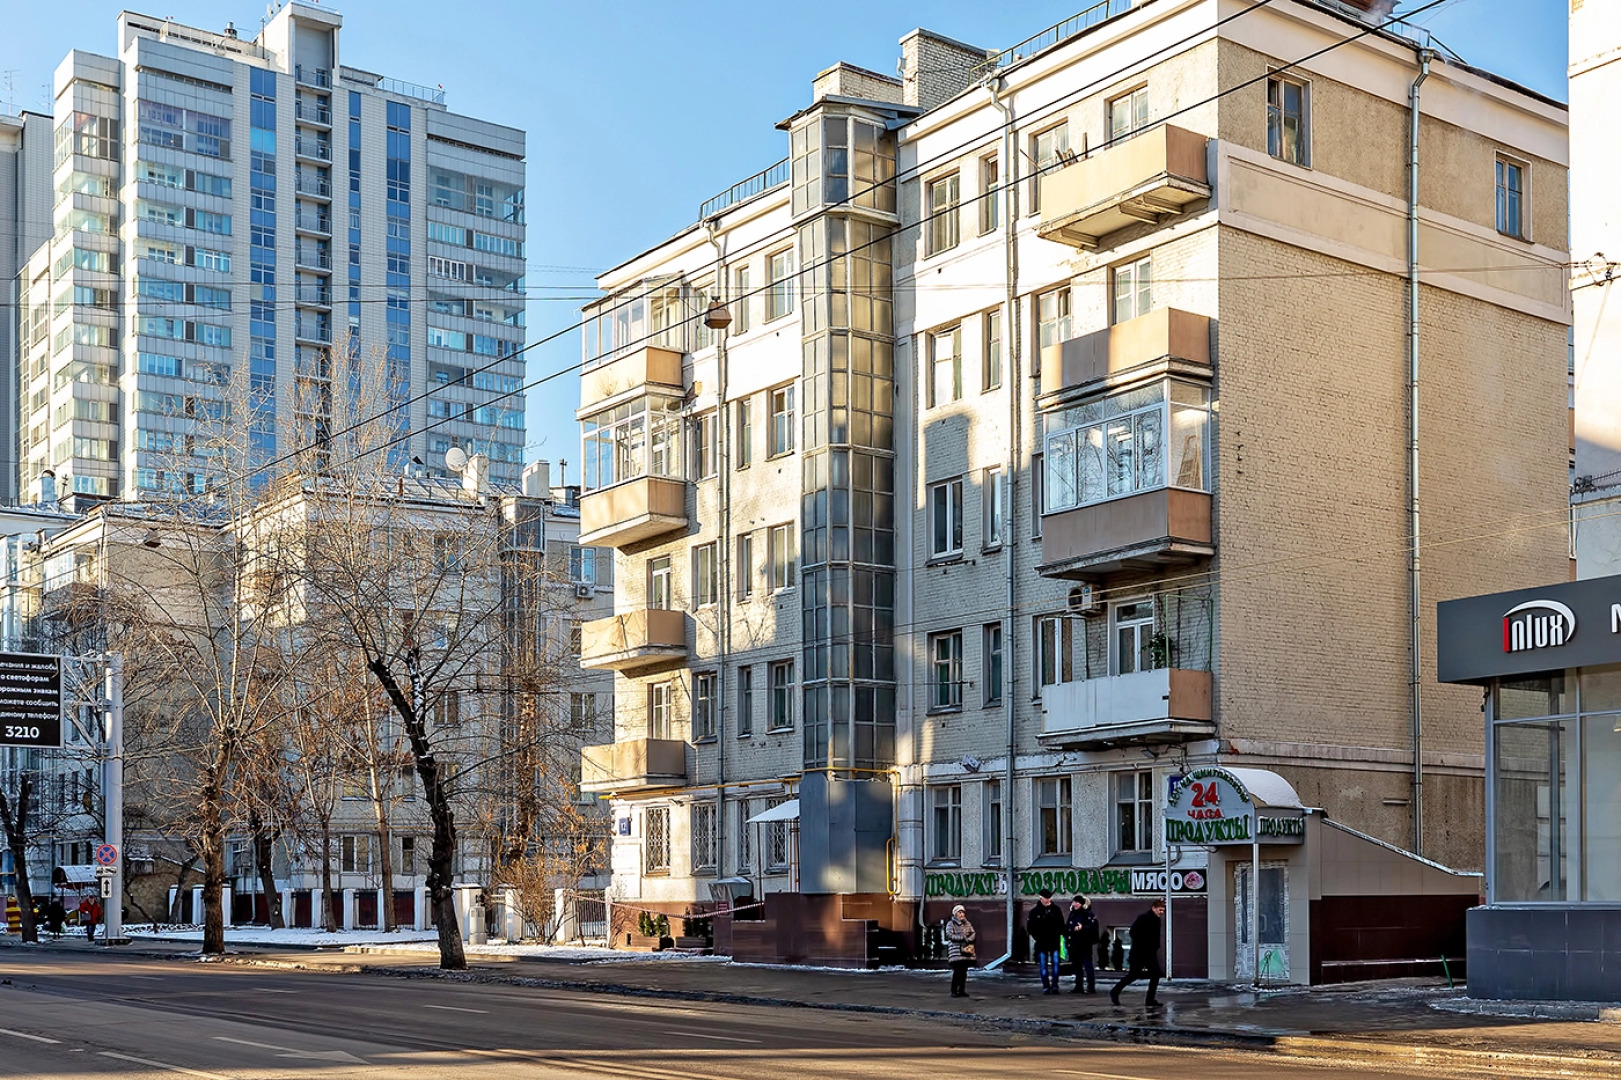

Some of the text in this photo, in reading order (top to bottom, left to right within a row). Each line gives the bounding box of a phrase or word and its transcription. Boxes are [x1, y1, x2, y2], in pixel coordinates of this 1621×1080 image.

[6, 674, 50, 682] светофорам
[27, 712, 59, 720] телефону
[5, 725, 40, 738] 3210
[1190, 781, 1220, 807] 24
[1187, 808, 1224, 820] ЧАСА
[1166, 814, 1251, 843] ПРОДУКТЫ
[1020, 869, 1131, 896] ХОЗТОВАРЫ
[1132, 872, 1183, 890] МЯСО
